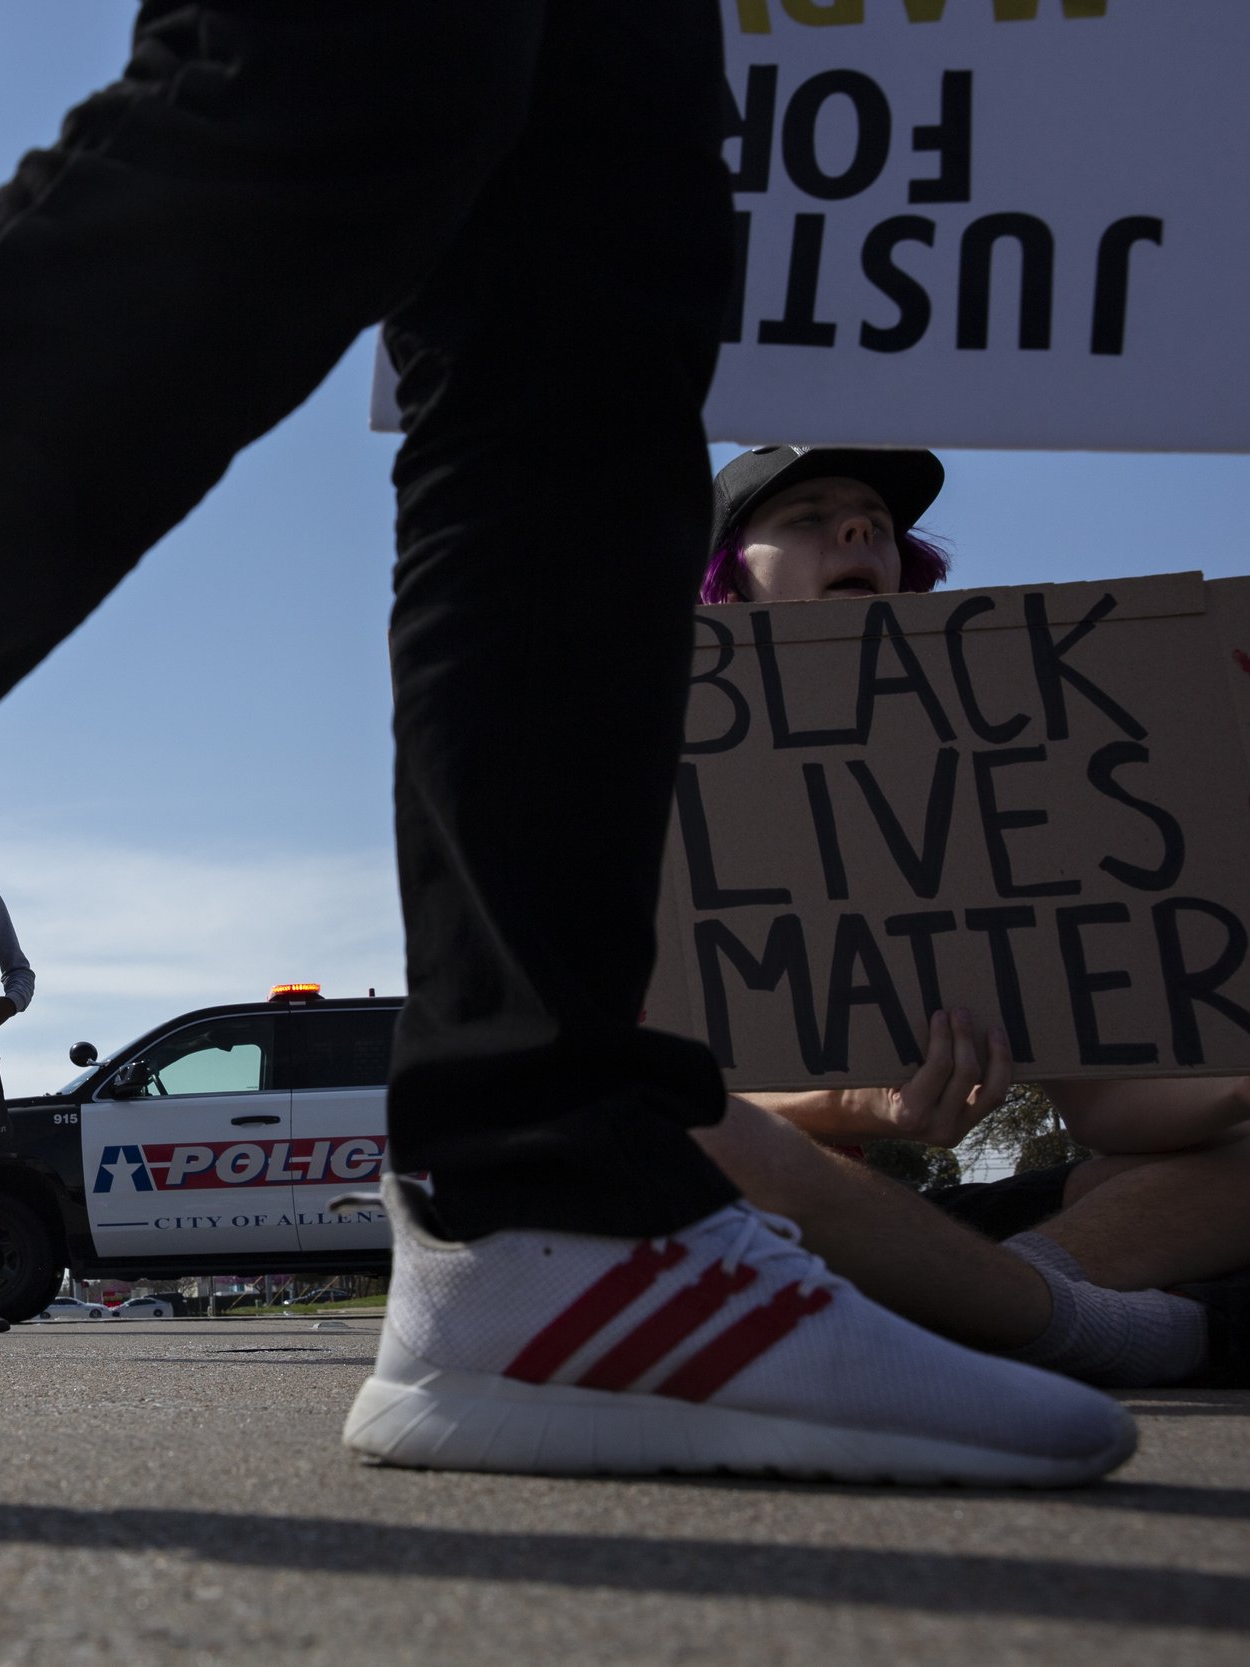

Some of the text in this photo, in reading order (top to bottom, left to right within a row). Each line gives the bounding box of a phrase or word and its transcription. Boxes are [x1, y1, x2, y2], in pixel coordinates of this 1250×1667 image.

[722, 64, 973, 205] FOR
[682, 592, 1149, 755] BLACK
[675, 740, 1186, 911] LIVES
[693, 897, 1250, 1075] MATTER
[53, 1112, 78, 1125] 915
[165, 1138, 390, 1186] POLIC
[154, 1210, 373, 1231] CITY OF ALLEN
